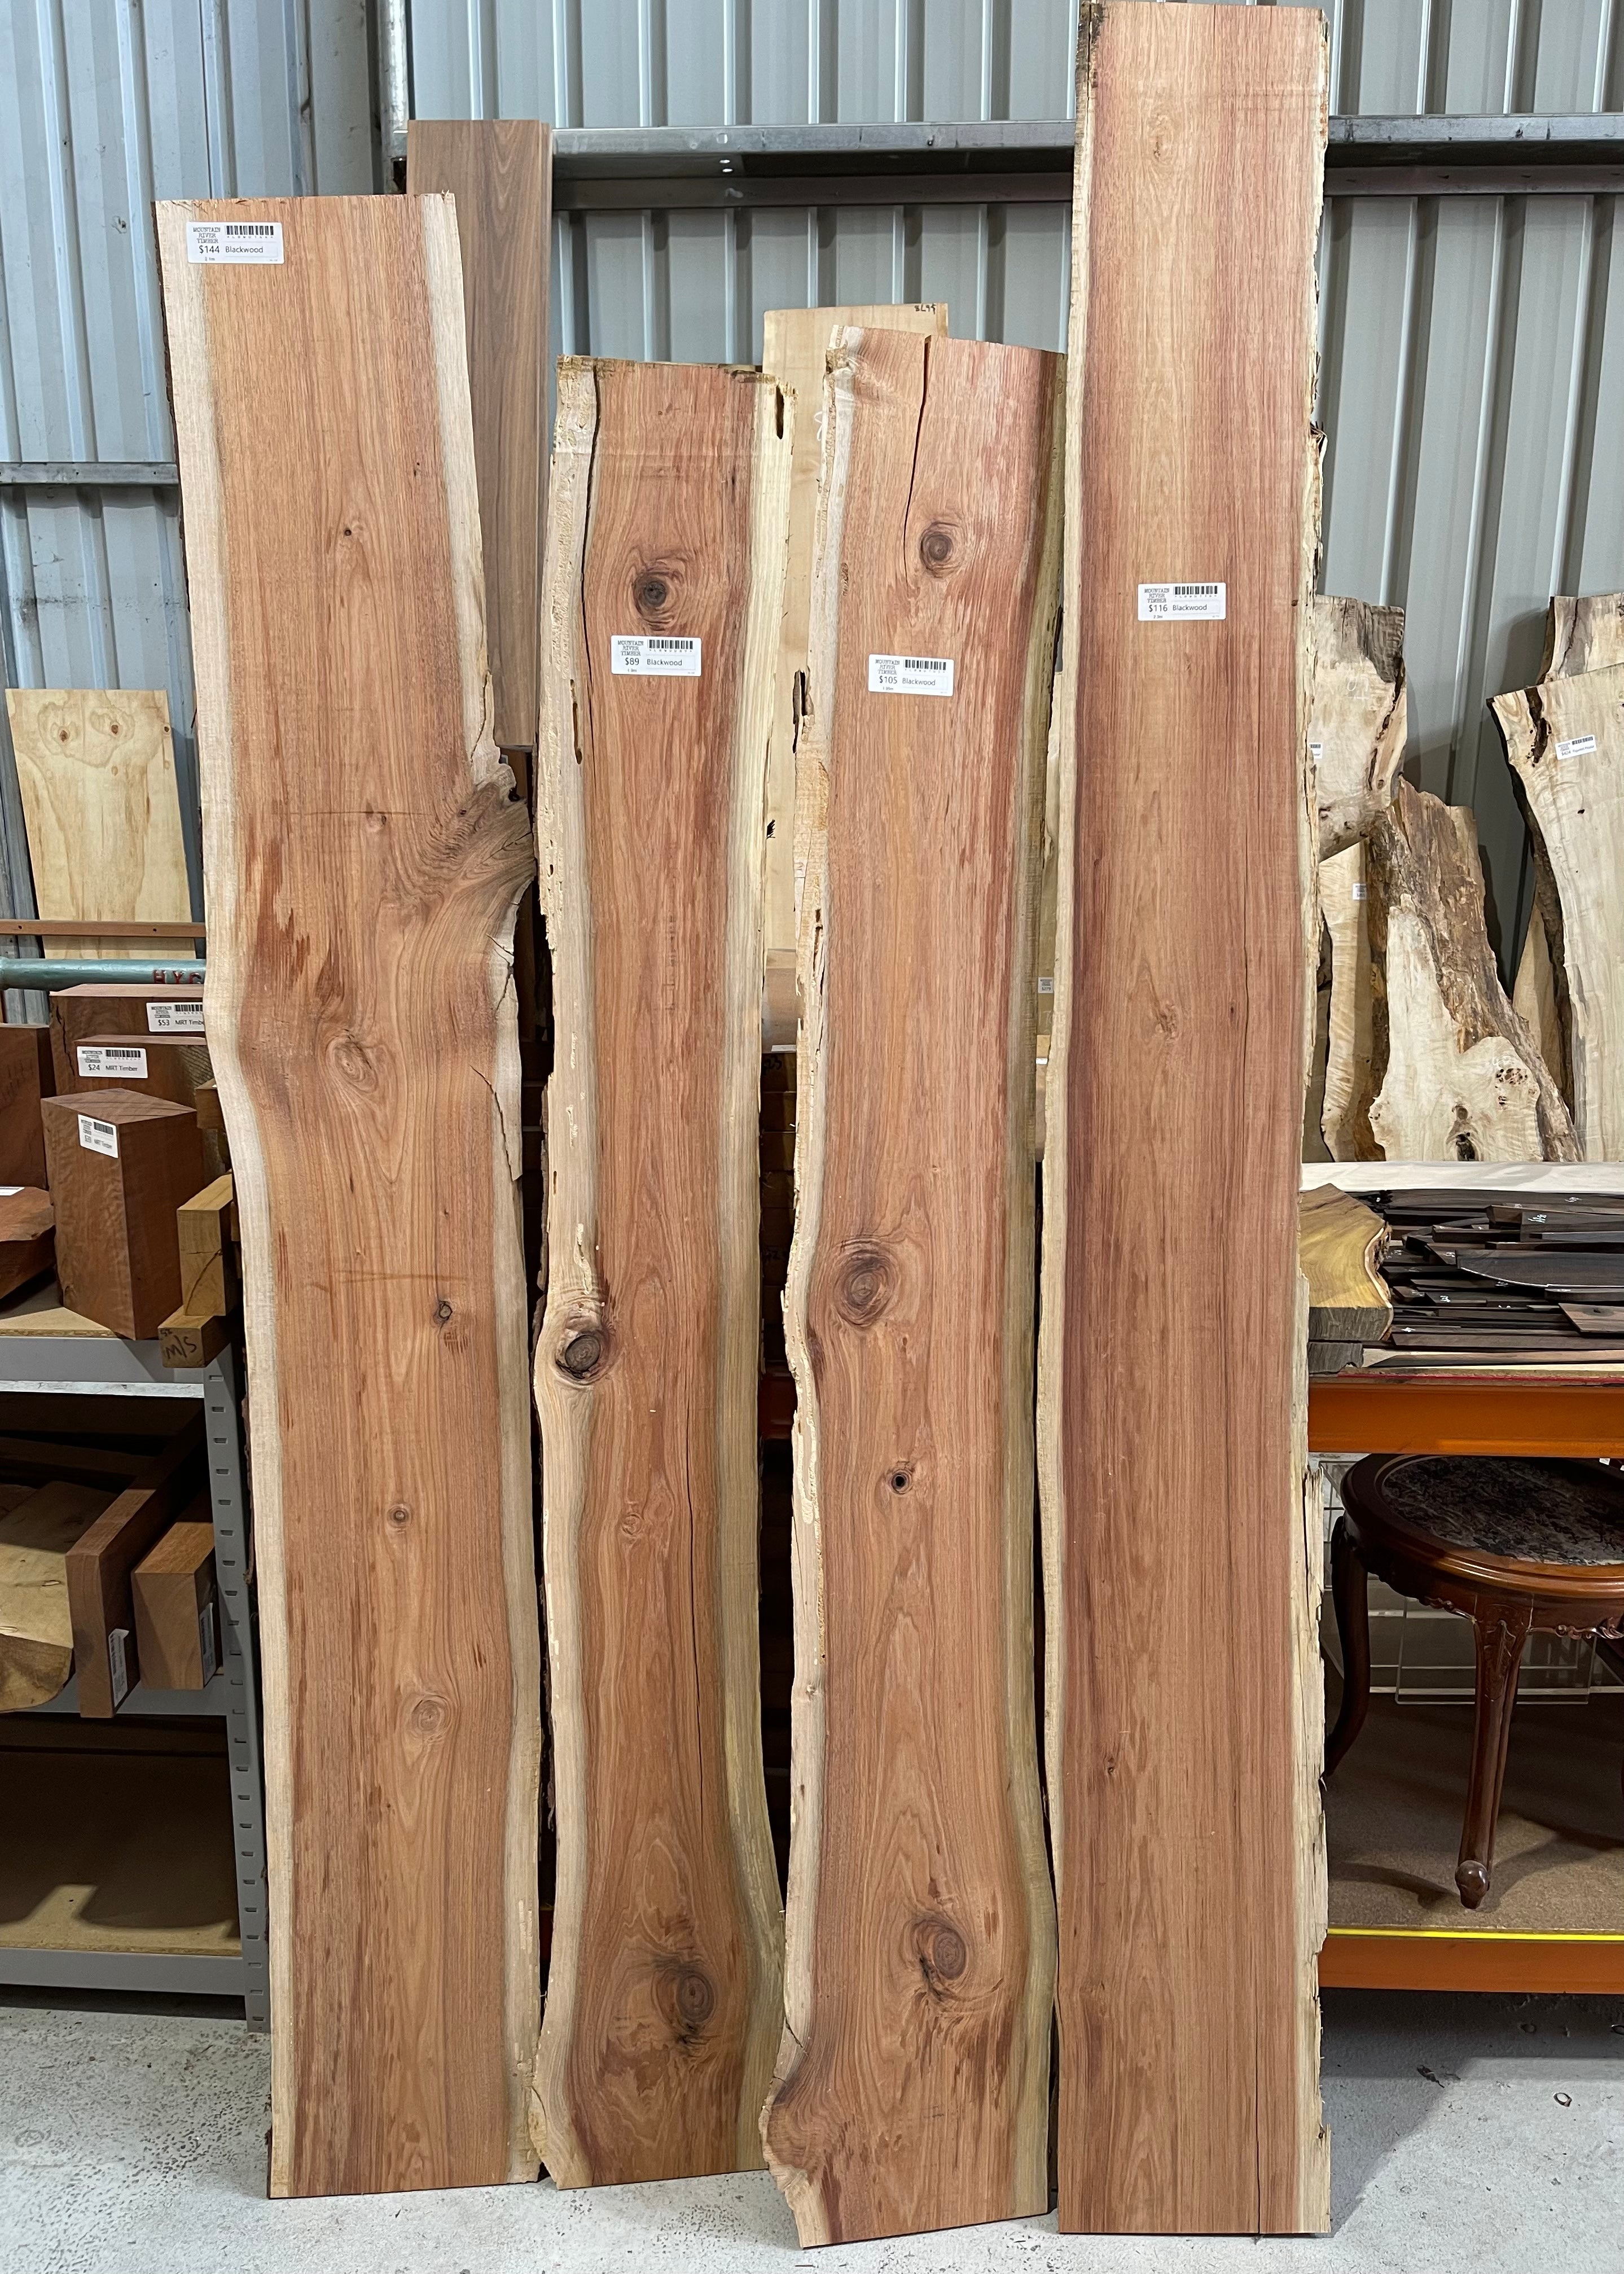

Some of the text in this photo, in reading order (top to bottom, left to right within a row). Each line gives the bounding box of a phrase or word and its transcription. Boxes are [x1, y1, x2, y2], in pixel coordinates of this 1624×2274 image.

[199, 245, 220, 254] $144
[625, 657, 639, 665] $89
[879, 676, 897, 684] $105
